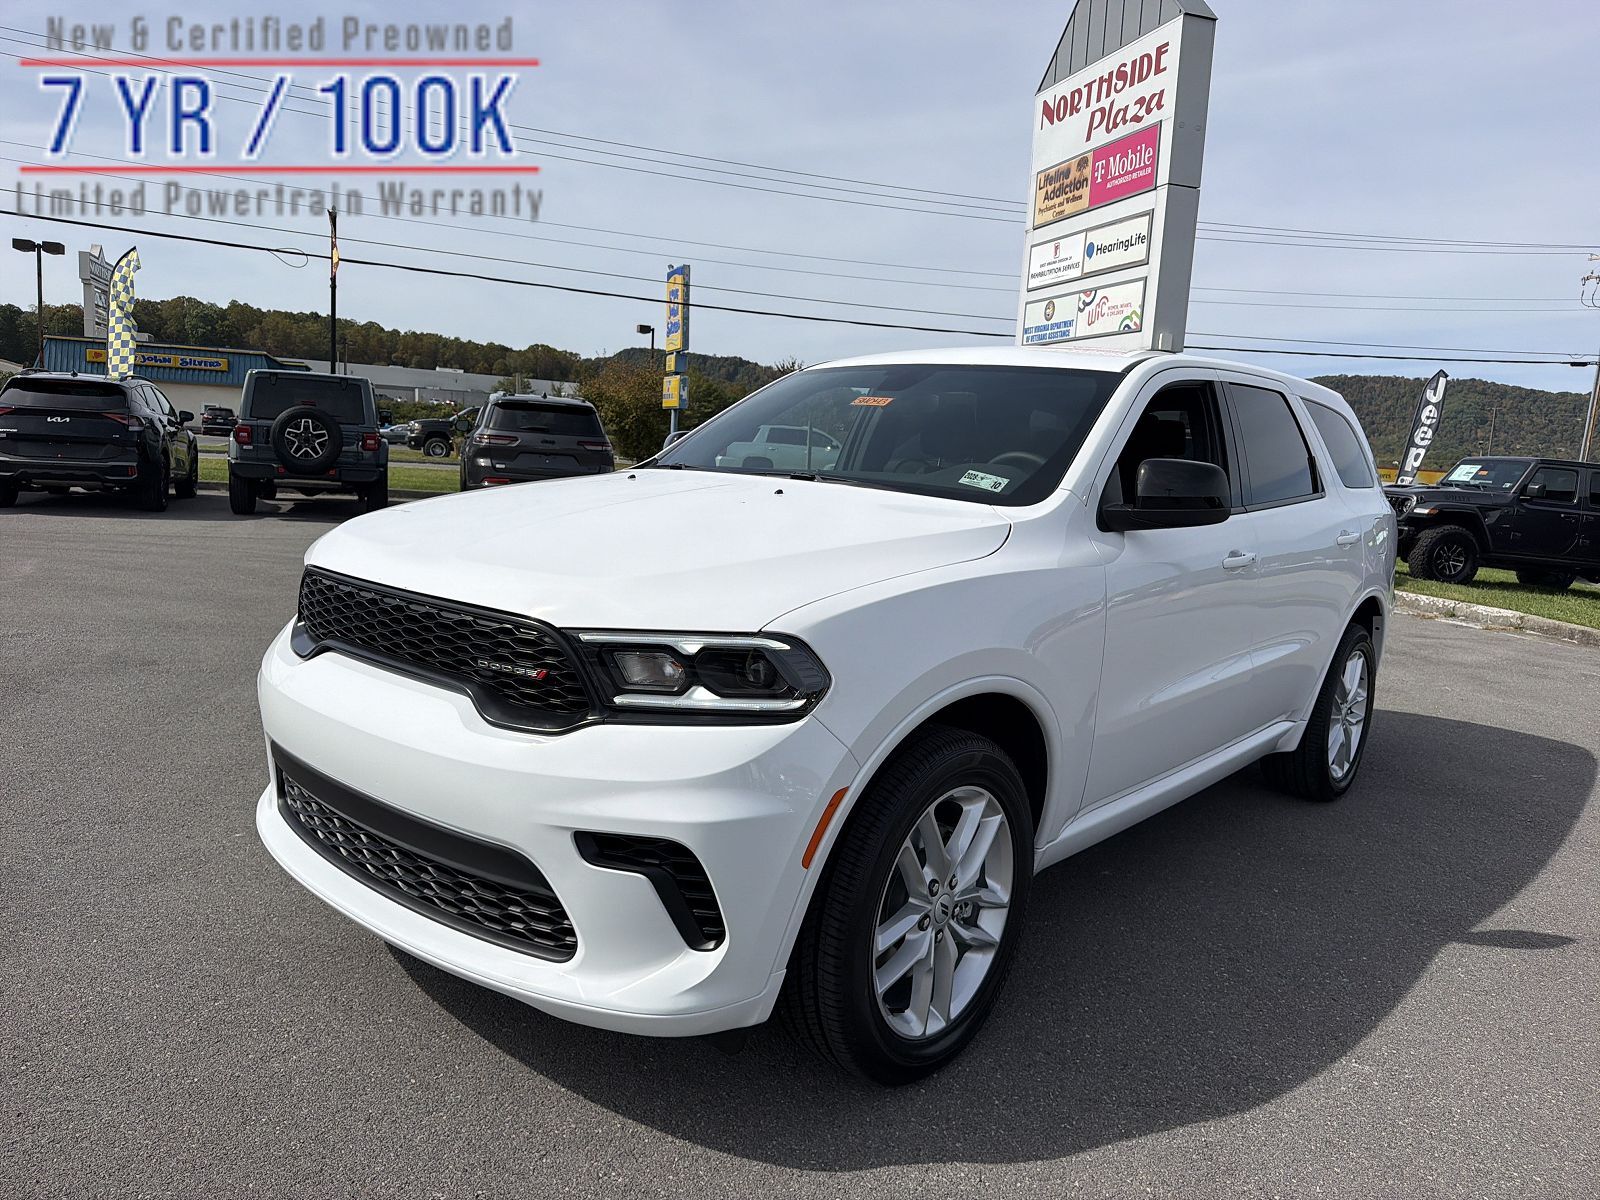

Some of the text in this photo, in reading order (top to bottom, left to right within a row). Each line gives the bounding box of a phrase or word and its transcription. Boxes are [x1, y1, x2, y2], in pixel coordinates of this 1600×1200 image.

[1040, 40, 1170, 131] NORTHSIDE
[1085, 88, 1166, 143] Plaza
[1107, 144, 1153, 180] Mobile
[1038, 167, 1072, 191] Lifeline
[1106, 167, 1151, 189] AUTHORIZED RETAILER
[1043, 177, 1089, 204] Addiction
[1095, 232, 1147, 256] HearingLife
[1048, 329, 1070, 341] ASSISTANCE
[1050, 319, 1074, 330] DEPARTMENT
[1404, 376, 1448, 471] Jeep
[991, 481, 1002, 489] 10
[477, 660, 538, 677] DODGE
